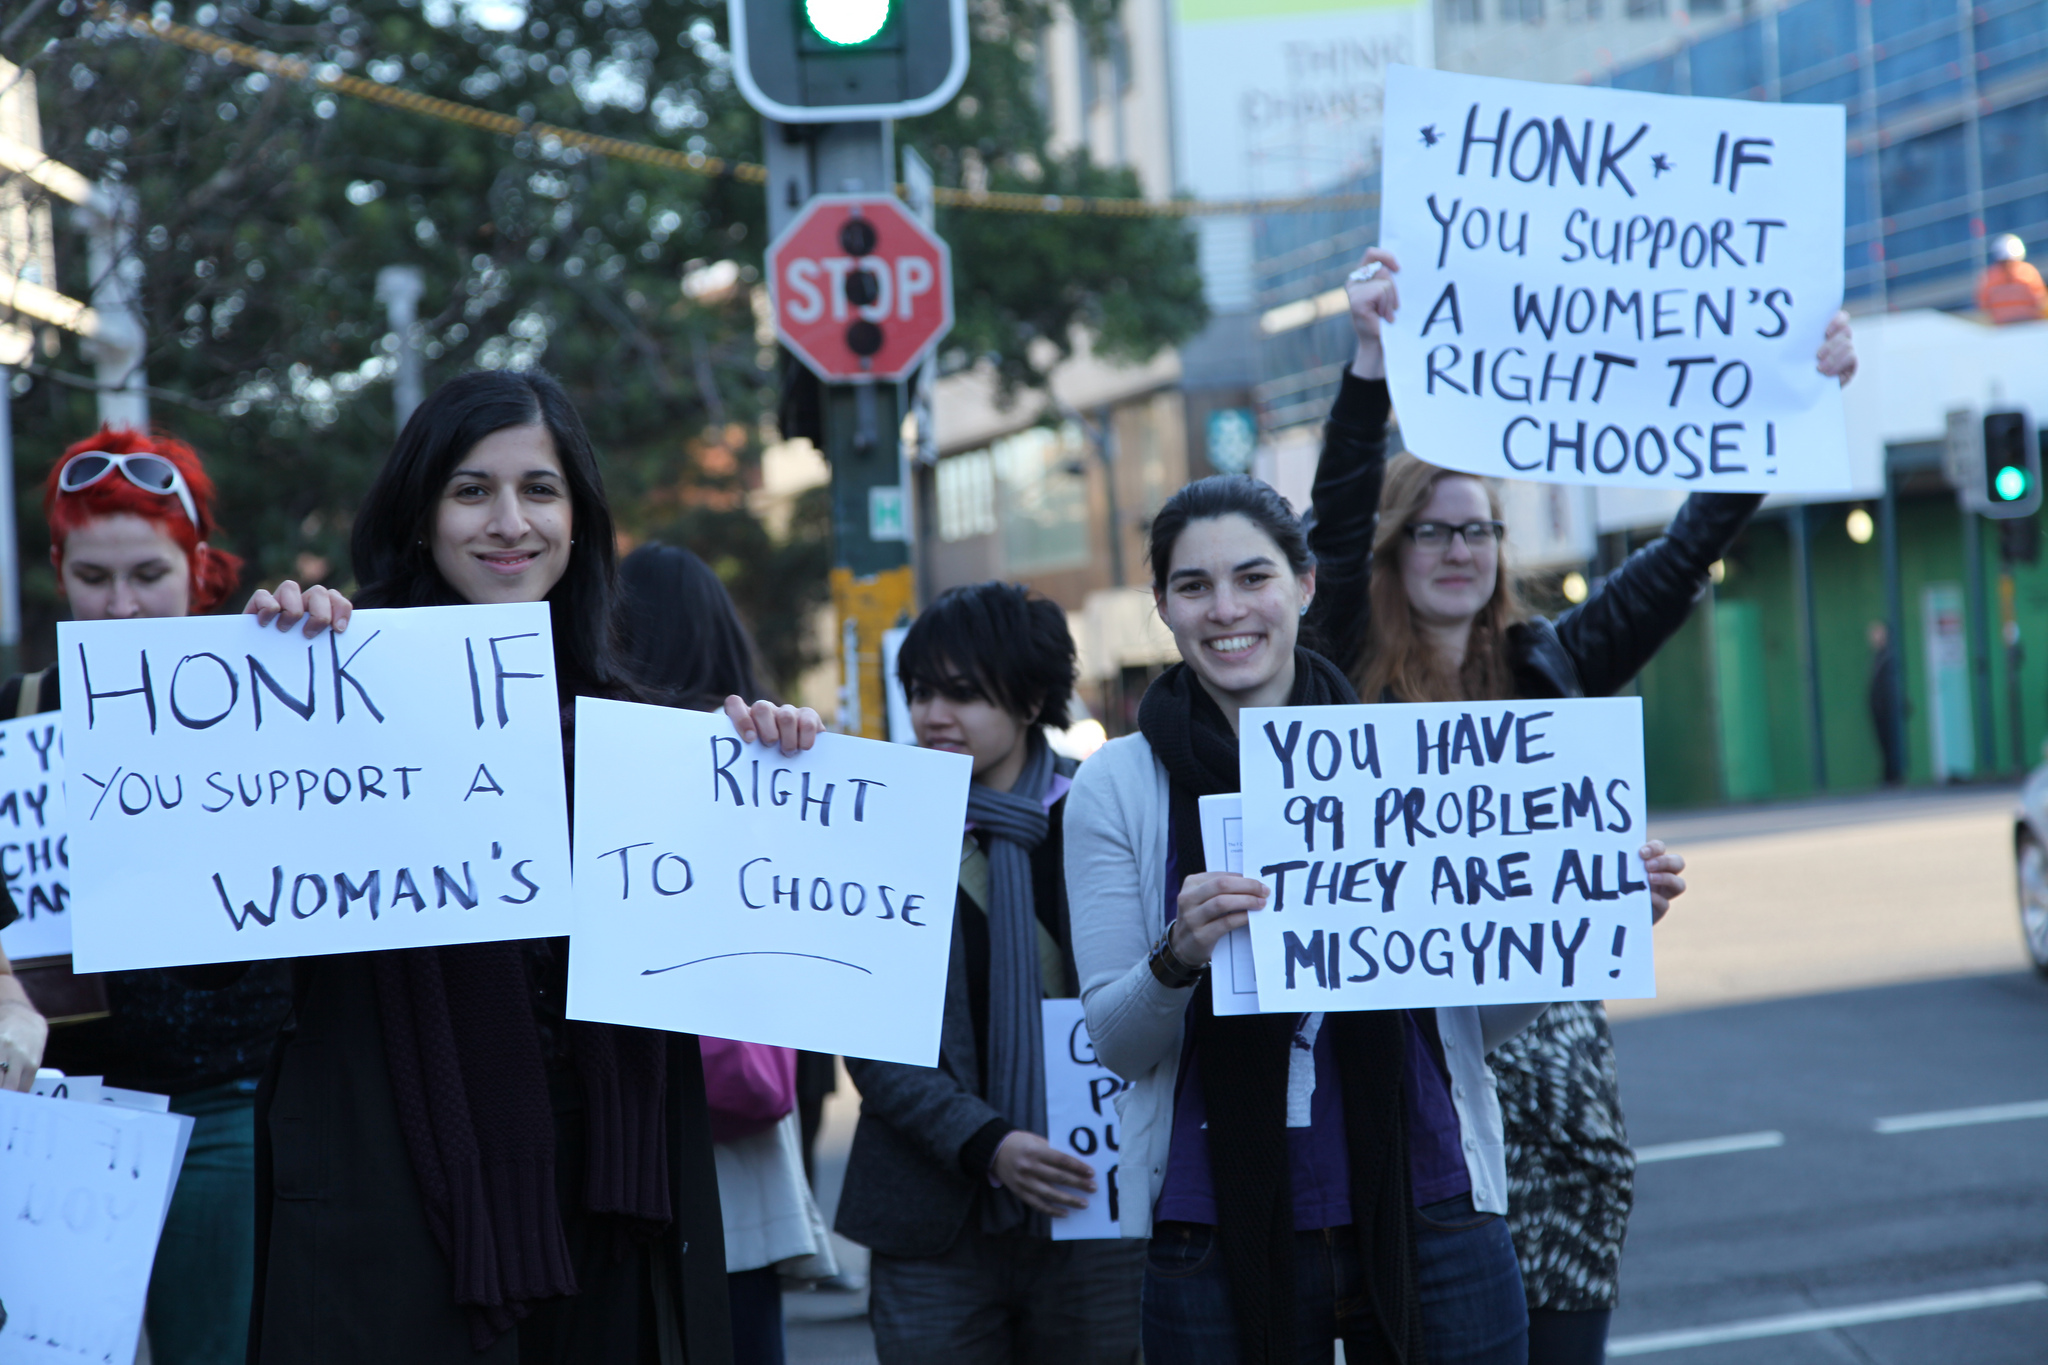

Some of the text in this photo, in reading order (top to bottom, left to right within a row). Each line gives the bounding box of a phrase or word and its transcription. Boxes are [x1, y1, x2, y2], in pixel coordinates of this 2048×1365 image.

[1713, 132, 1773, 193] IF
[1427, 194, 1786, 269] YOU SUPPORT
[786, 256, 934, 324] STOP
[1421, 281, 1792, 341] A WOMEN'S
[1427, 344, 1752, 409] RIGHT TO
[1502, 416, 1777, 479] CHOOSE!
[79, 629, 545, 735] HONK IF
[710, 734, 888, 827] RIGHT
[1263, 711, 1555, 789] YOU HAVE
[82, 764, 504, 821] YOU SUPPORT A
[1284, 775, 1633, 852] 99 PROBLEMS
[212, 841, 540, 931] WOMAN'S
[597, 842, 927, 927] TO CHOOSE
[1260, 849, 1647, 913] THEY ARE ALL
[1283, 916, 1627, 990] MISOGYNY!
